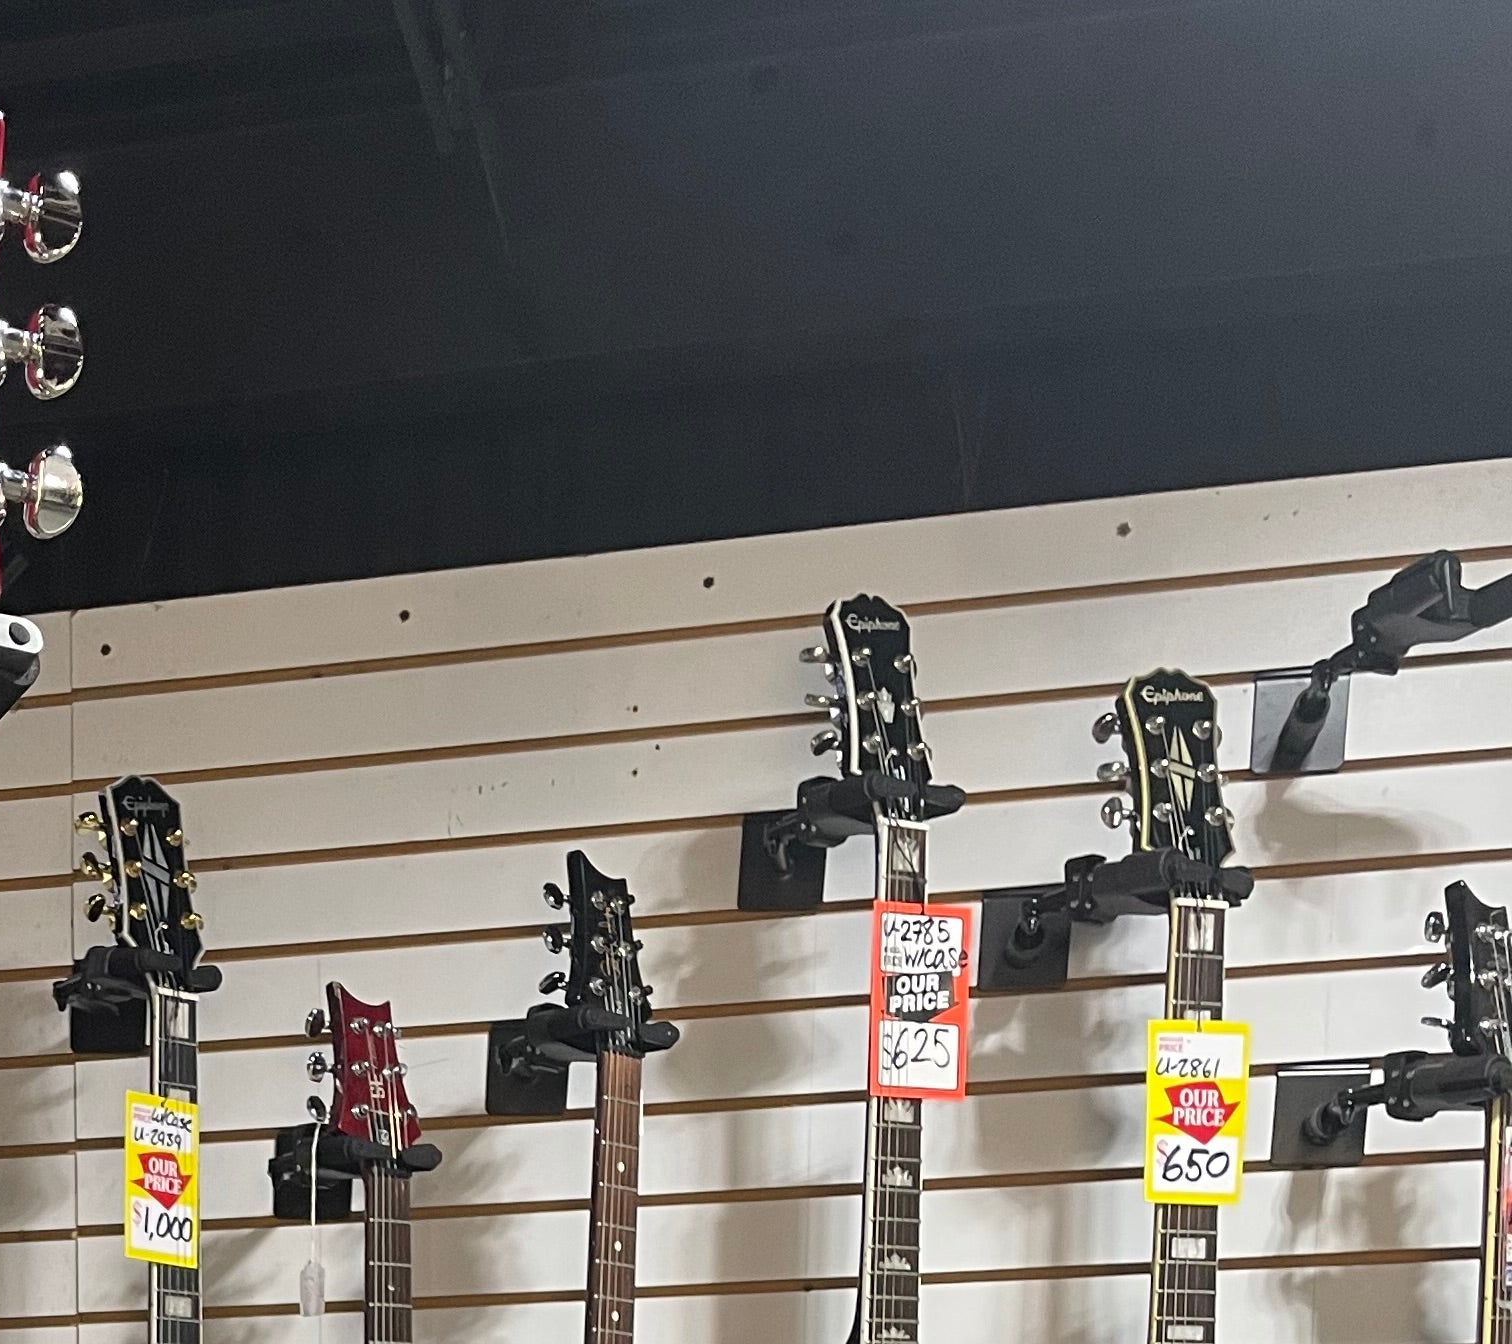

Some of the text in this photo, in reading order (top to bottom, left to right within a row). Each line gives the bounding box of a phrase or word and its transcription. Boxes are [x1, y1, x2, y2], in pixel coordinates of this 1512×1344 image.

[1140, 685, 1204, 706] Epiphone
[896, 973, 940, 994] OUR
[889, 991, 950, 1014] PRICE
[882, 1027, 951, 1071] $625
[1179, 1088, 1220, 1107] OUR
[1172, 1106, 1226, 1127] PRICE
[148, 1156, 178, 1178] OUR
[1156, 1139, 1230, 1182] $650
[144, 1174, 183, 1196] PRICE
[132, 1200, 194, 1243] $1,000
